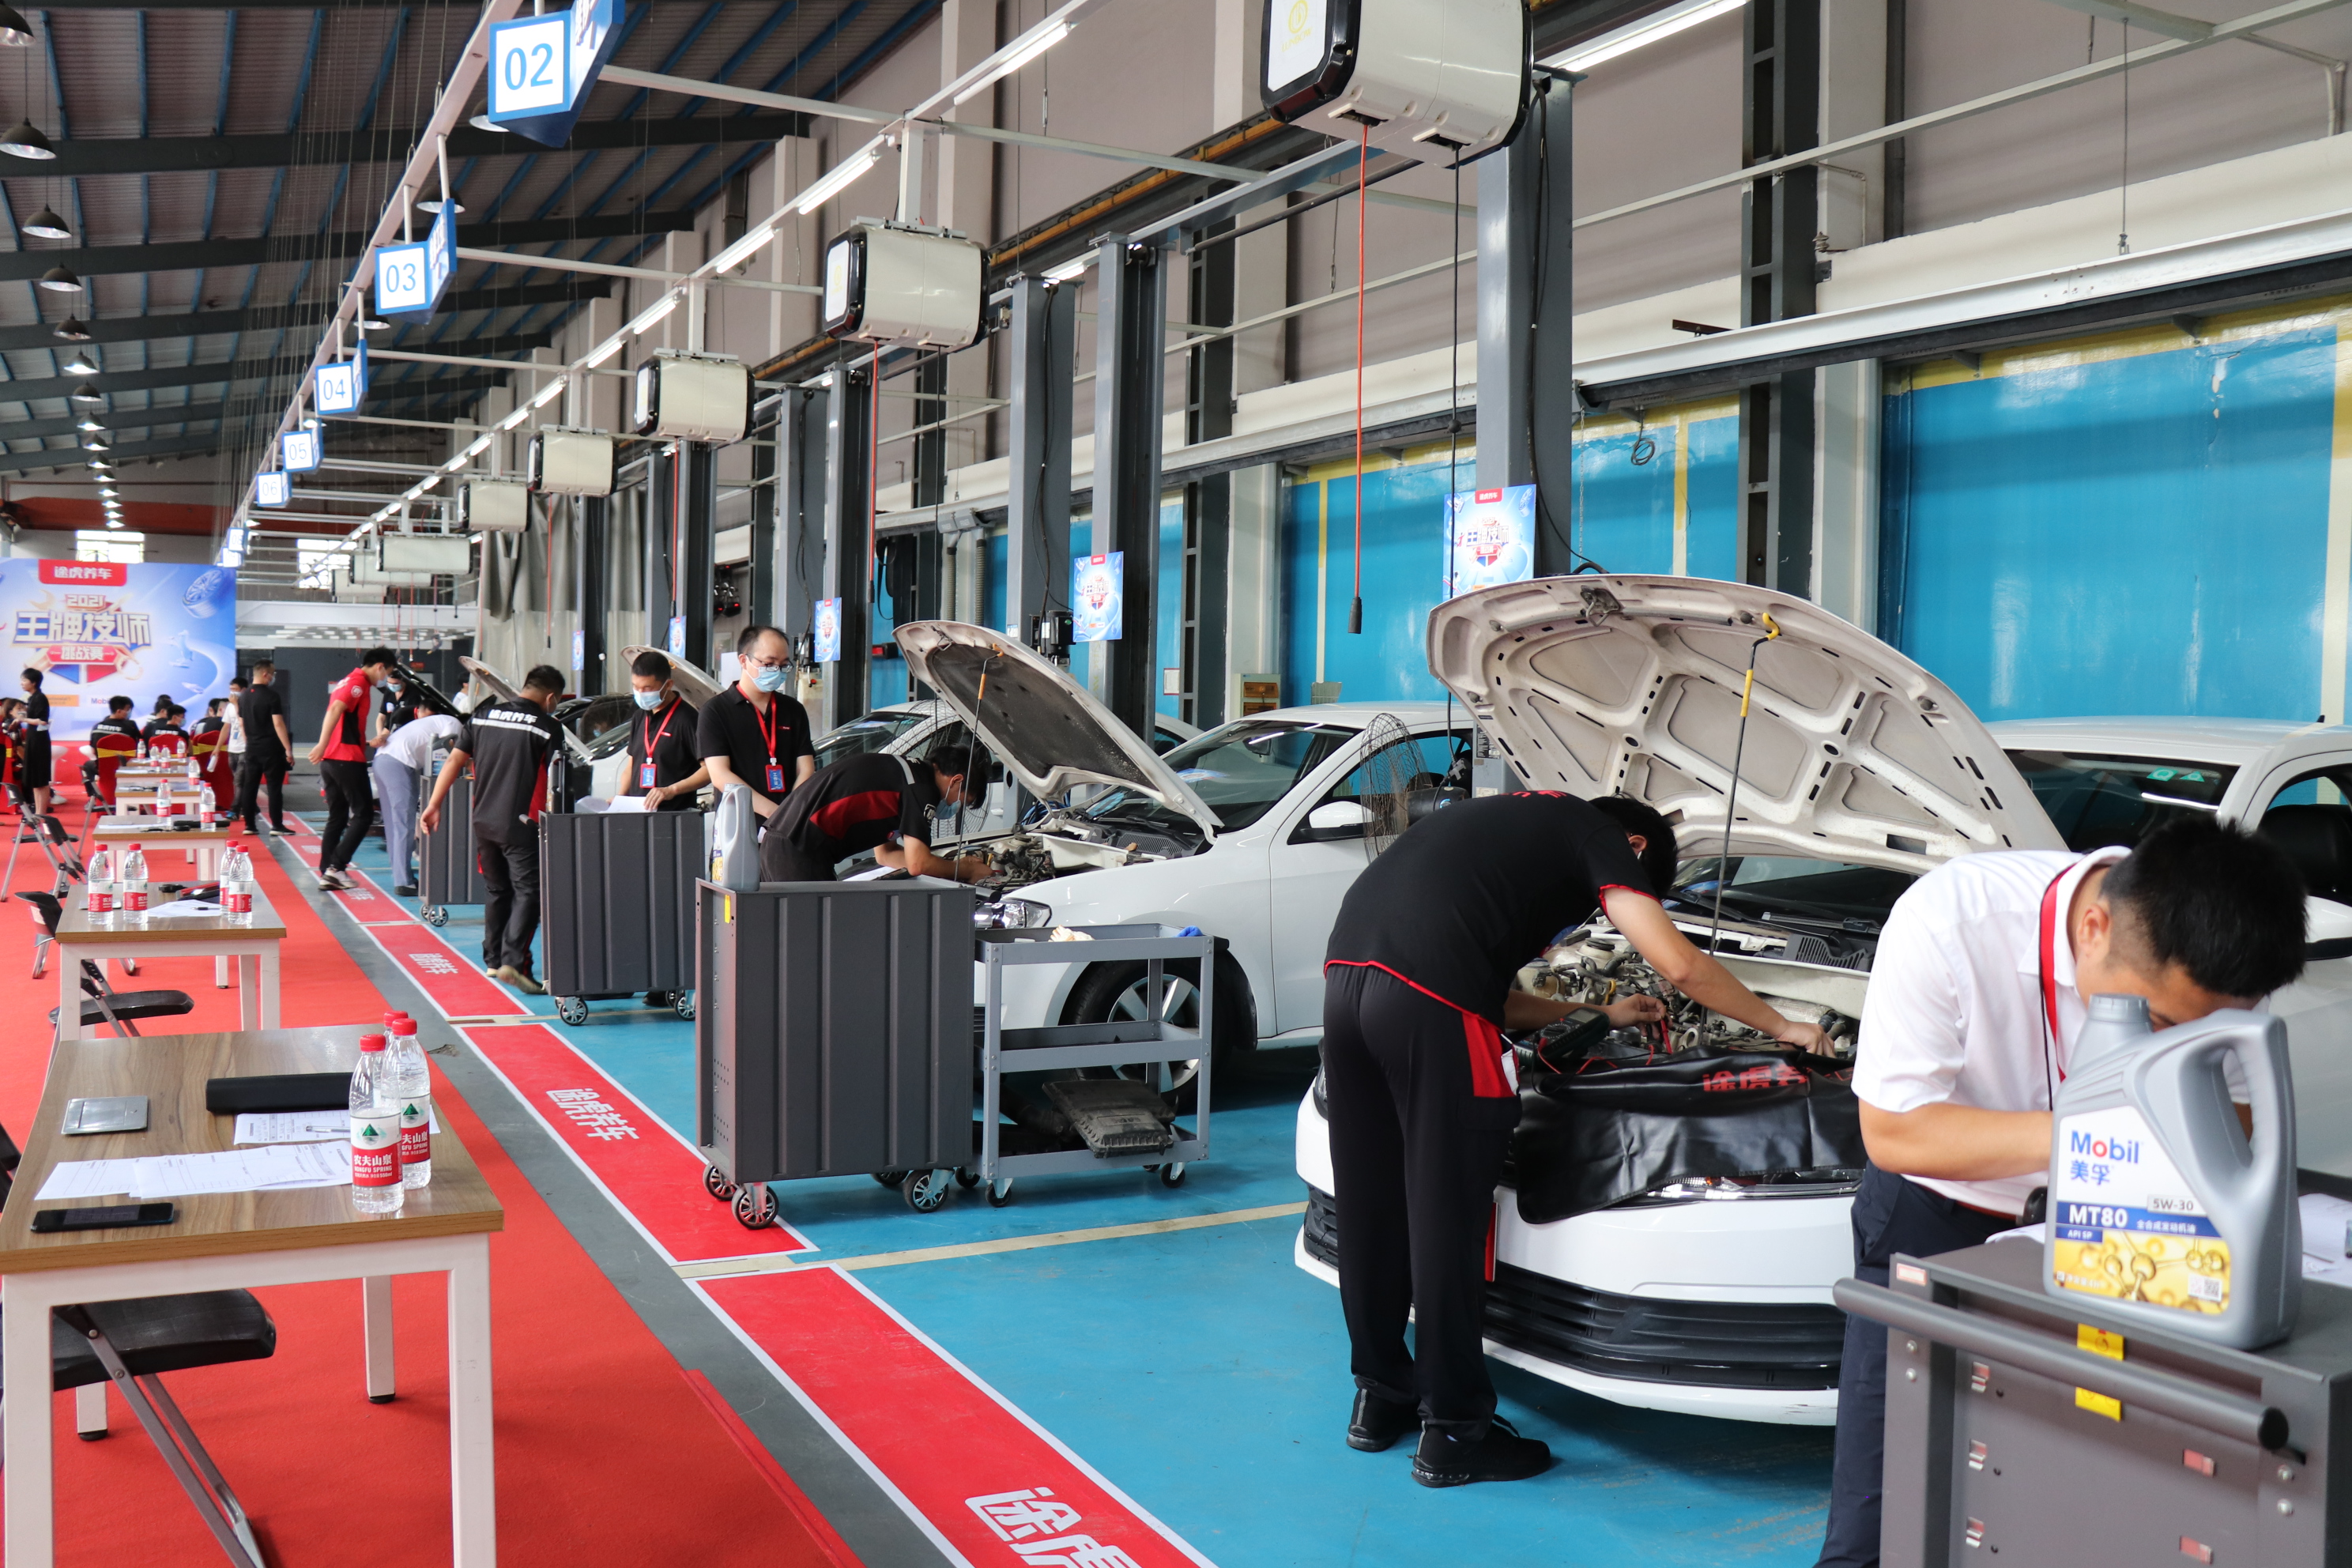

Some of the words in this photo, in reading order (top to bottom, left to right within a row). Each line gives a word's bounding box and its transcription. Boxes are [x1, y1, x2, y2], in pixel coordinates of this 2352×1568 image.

[504, 43, 553, 91] 02
[386, 262, 416, 293] 03
[323, 379, 345, 401] 04
[288, 443, 307, 460] 05
[262, 481, 277, 496] 06
[54, 566, 113, 579] 途虎养车
[66, 594, 104, 607] 2021
[13, 611, 150, 646] 王牌技师
[488, 709, 537, 724] 途虎养车
[545, 1087, 640, 1141] 途虎养车
[401, 1131, 428, 1145] 夫山泉
[2071, 1131, 2139, 1163] Mobil
[354, 1154, 392, 1167] 农夫山泉
[2070, 1159, 2110, 1185] 美孚
[2153, 1198, 2194, 1211] 5W-30
[2069, 1204, 2128, 1227] MT80
[2137, 1219, 2196, 1234] 全合成发动机油
